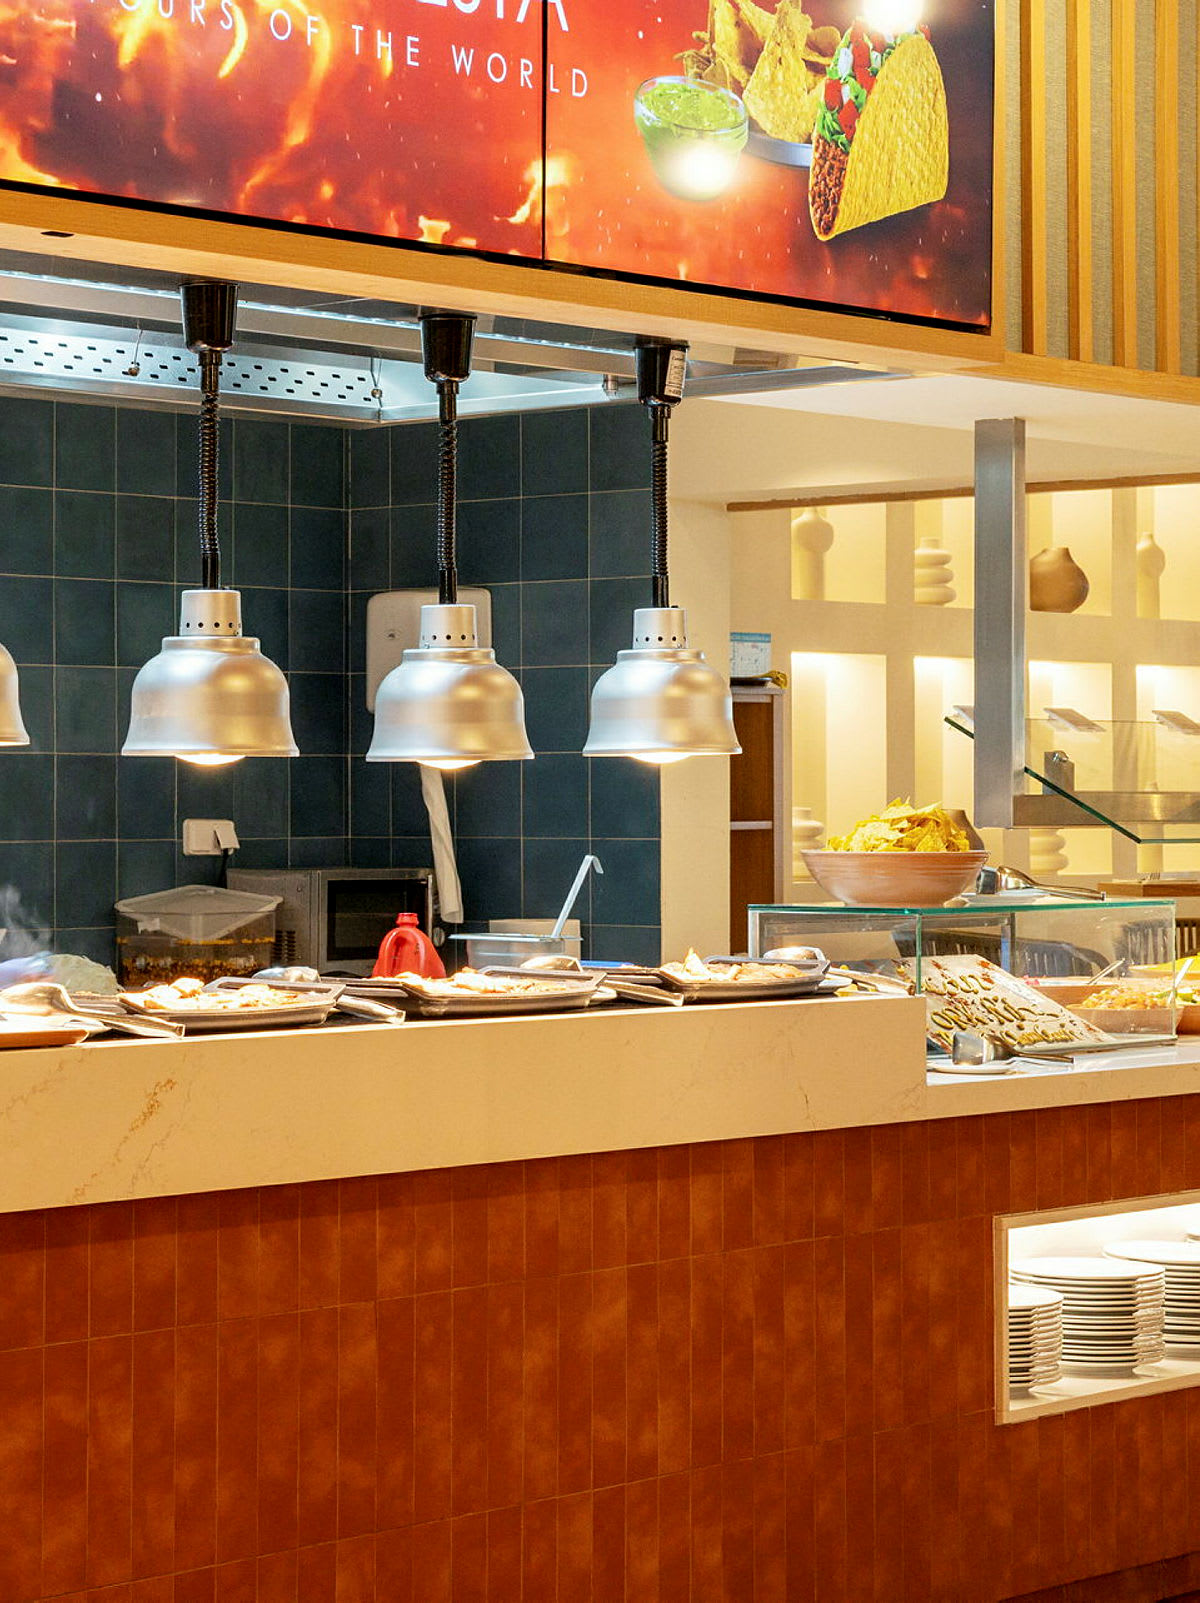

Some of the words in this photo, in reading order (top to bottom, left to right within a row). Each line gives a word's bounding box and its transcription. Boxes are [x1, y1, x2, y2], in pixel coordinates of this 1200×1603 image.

[90, 0, 233, 30] URS
[270, 9, 319, 46] OF
[351, 24, 420, 67] THE
[451, 44, 588, 98] WORLD
